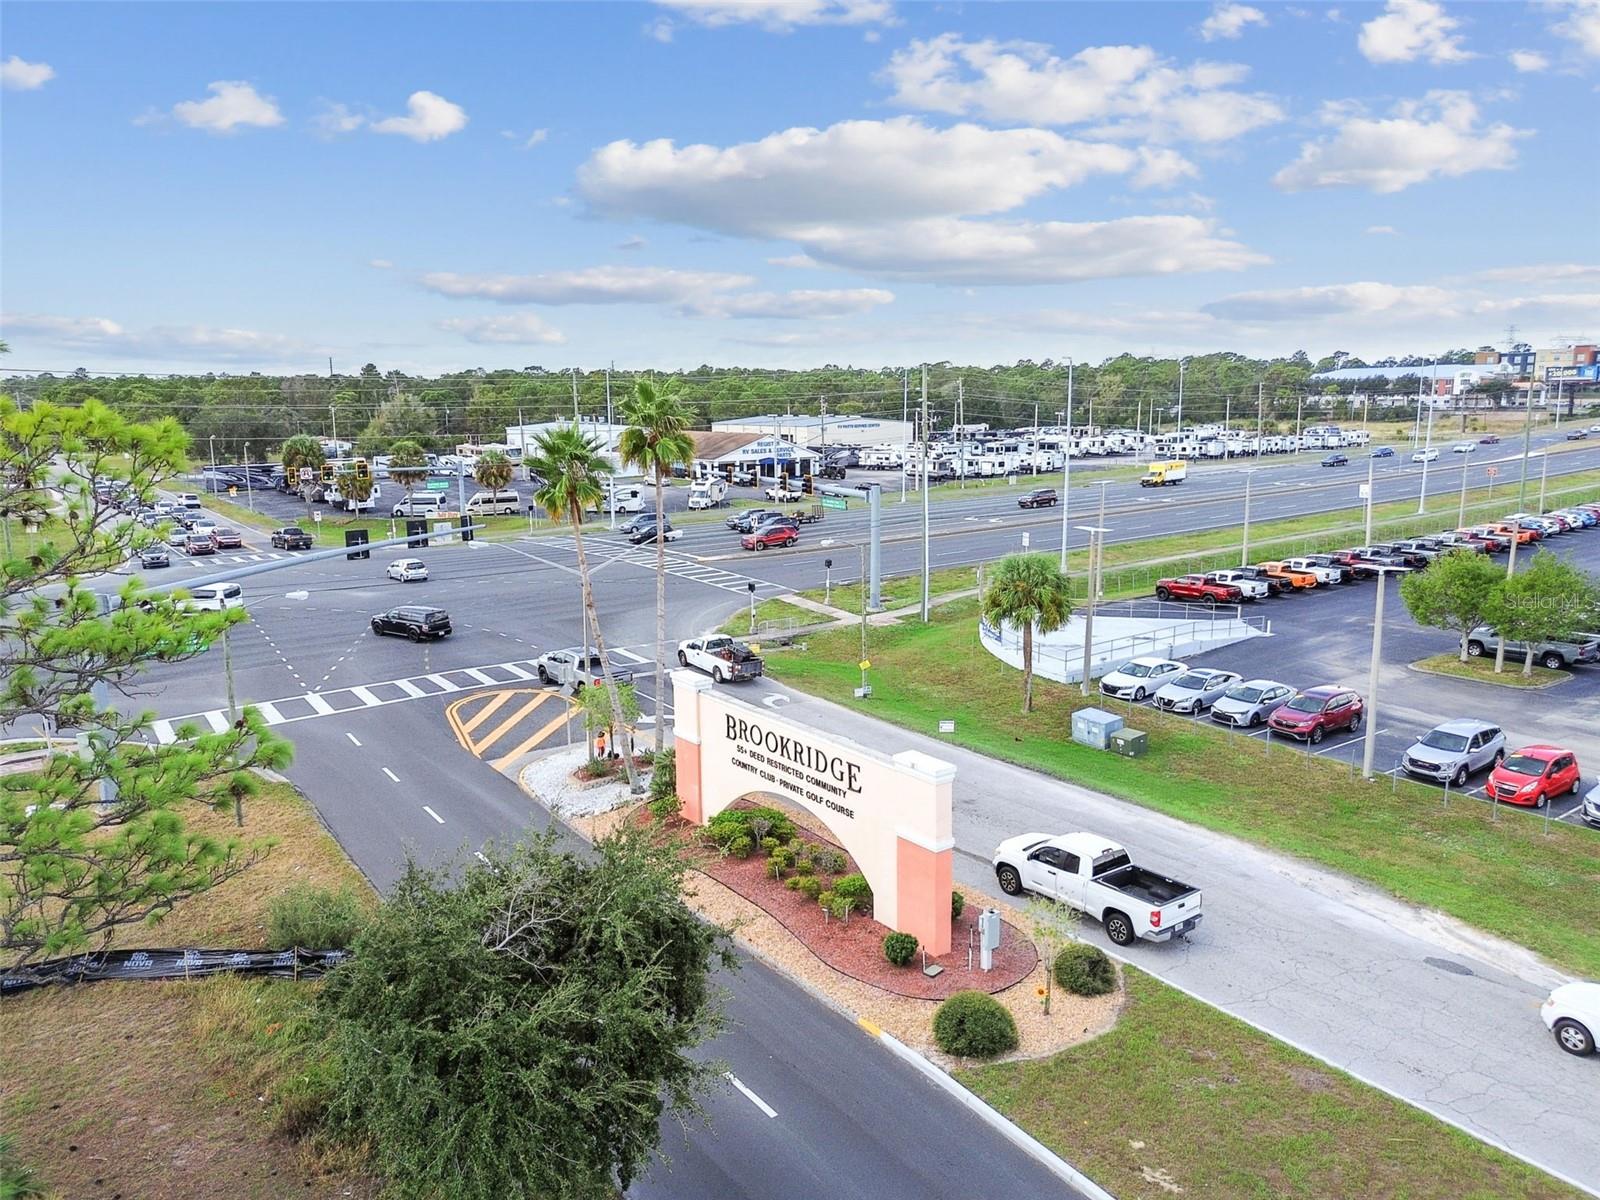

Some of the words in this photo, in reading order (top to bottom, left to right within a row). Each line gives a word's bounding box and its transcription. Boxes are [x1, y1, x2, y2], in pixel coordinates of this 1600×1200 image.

[725, 713, 862, 794] BROOKRIDGE
[736, 744, 747, 754] 55+
[750, 750, 765, 763] DEED
[766, 757, 804, 780] RESTRICTED
[805, 774, 847, 798] COMMUNITY
[731, 757, 758, 774] COUNTRY
[779, 778, 804, 796] PRIVATE
[805, 790, 824, 804] GOLF
[825, 799, 855, 820] COURSE
